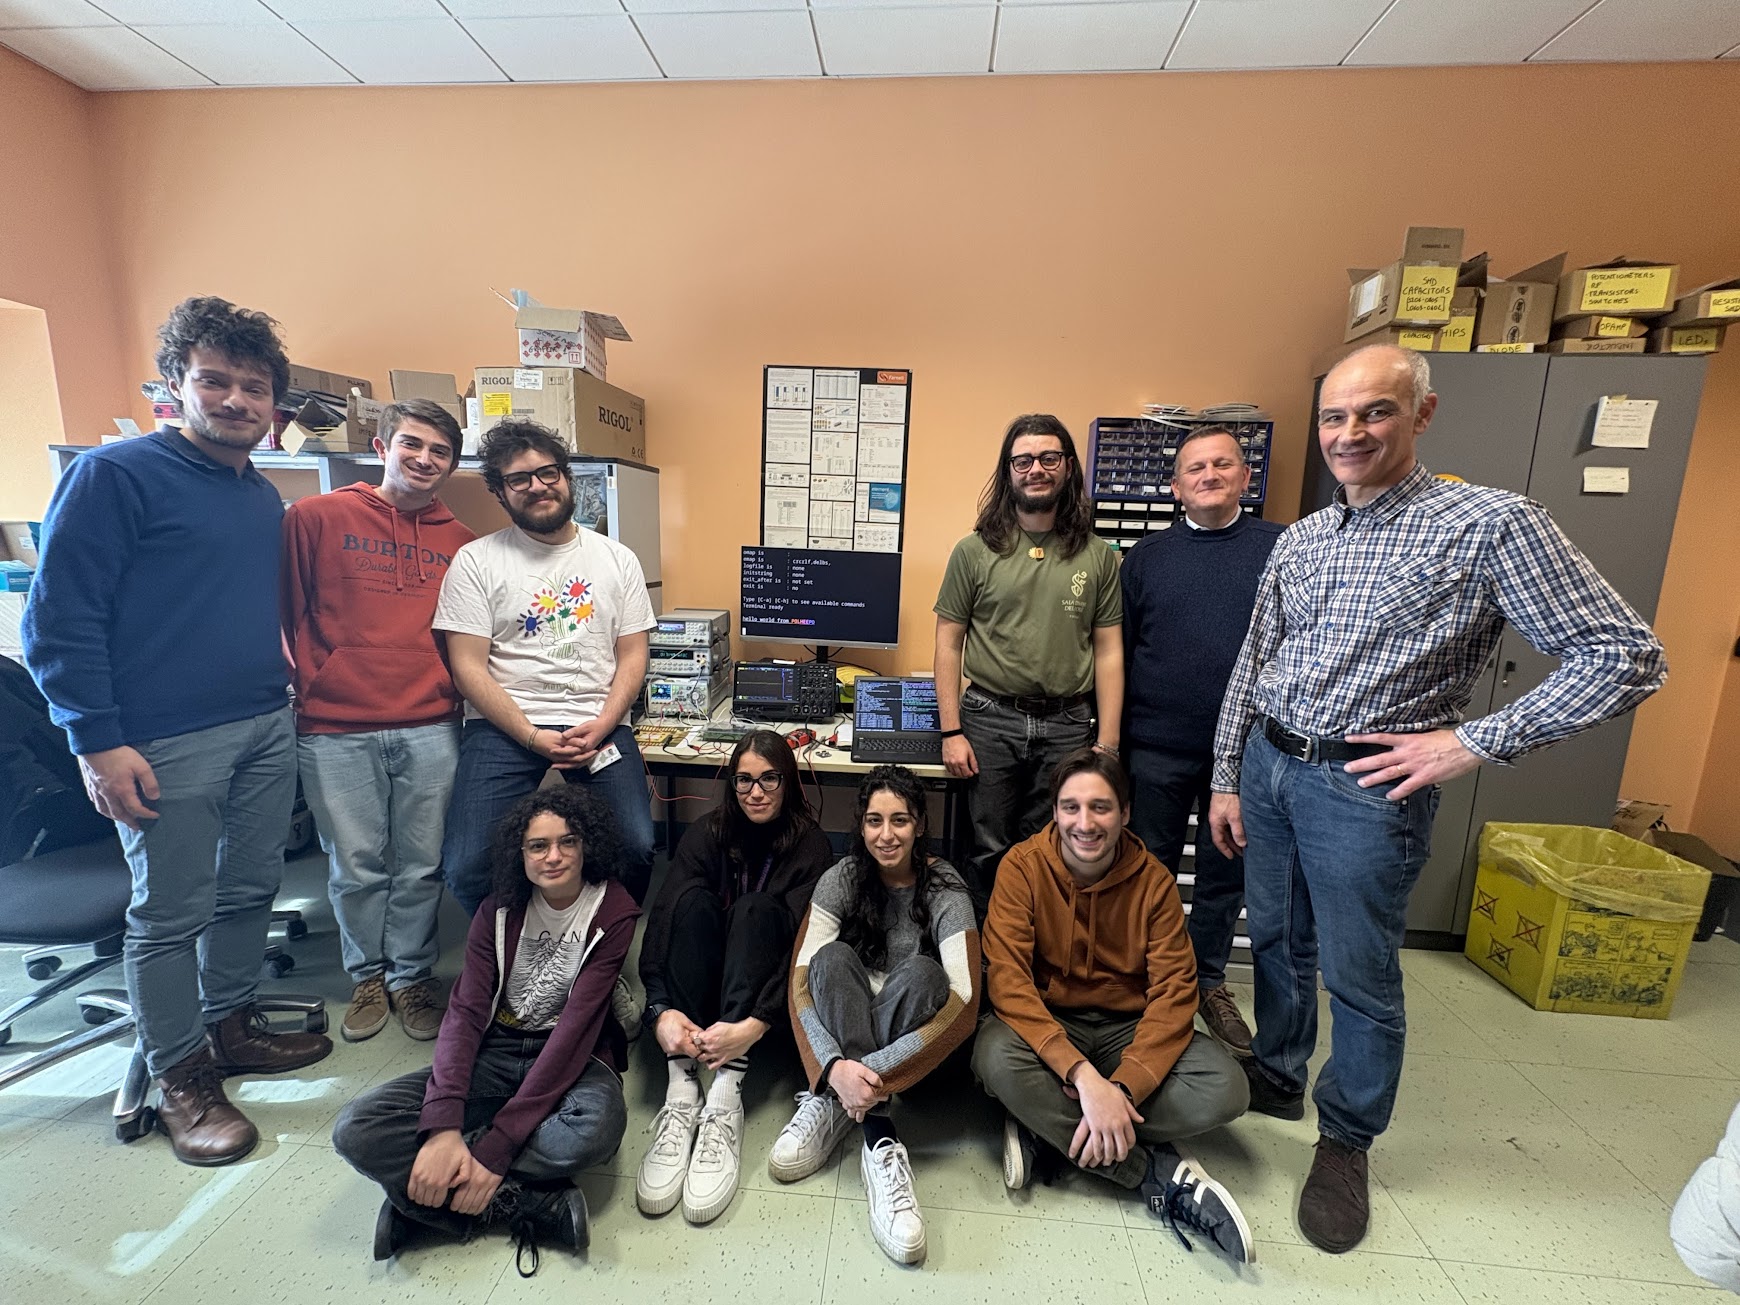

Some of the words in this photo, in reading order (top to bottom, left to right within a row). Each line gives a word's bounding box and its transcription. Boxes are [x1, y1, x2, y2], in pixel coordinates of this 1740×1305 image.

[1422, 276, 1437, 286] SMD
[1402, 286, 1450, 296] CAPACITORS
[1588, 288, 1638, 297] TRANSISTORS
[1442, 328, 1466, 338] HIPS
[1679, 334, 1708, 346] LEDs
[482, 377, 512, 385] RIGOL
[598, 406, 632, 432] RIGOL
[342, 534, 452, 566] BURTON
[355, 556, 398, 574] Durabl
[405, 565, 436, 580] Gods
